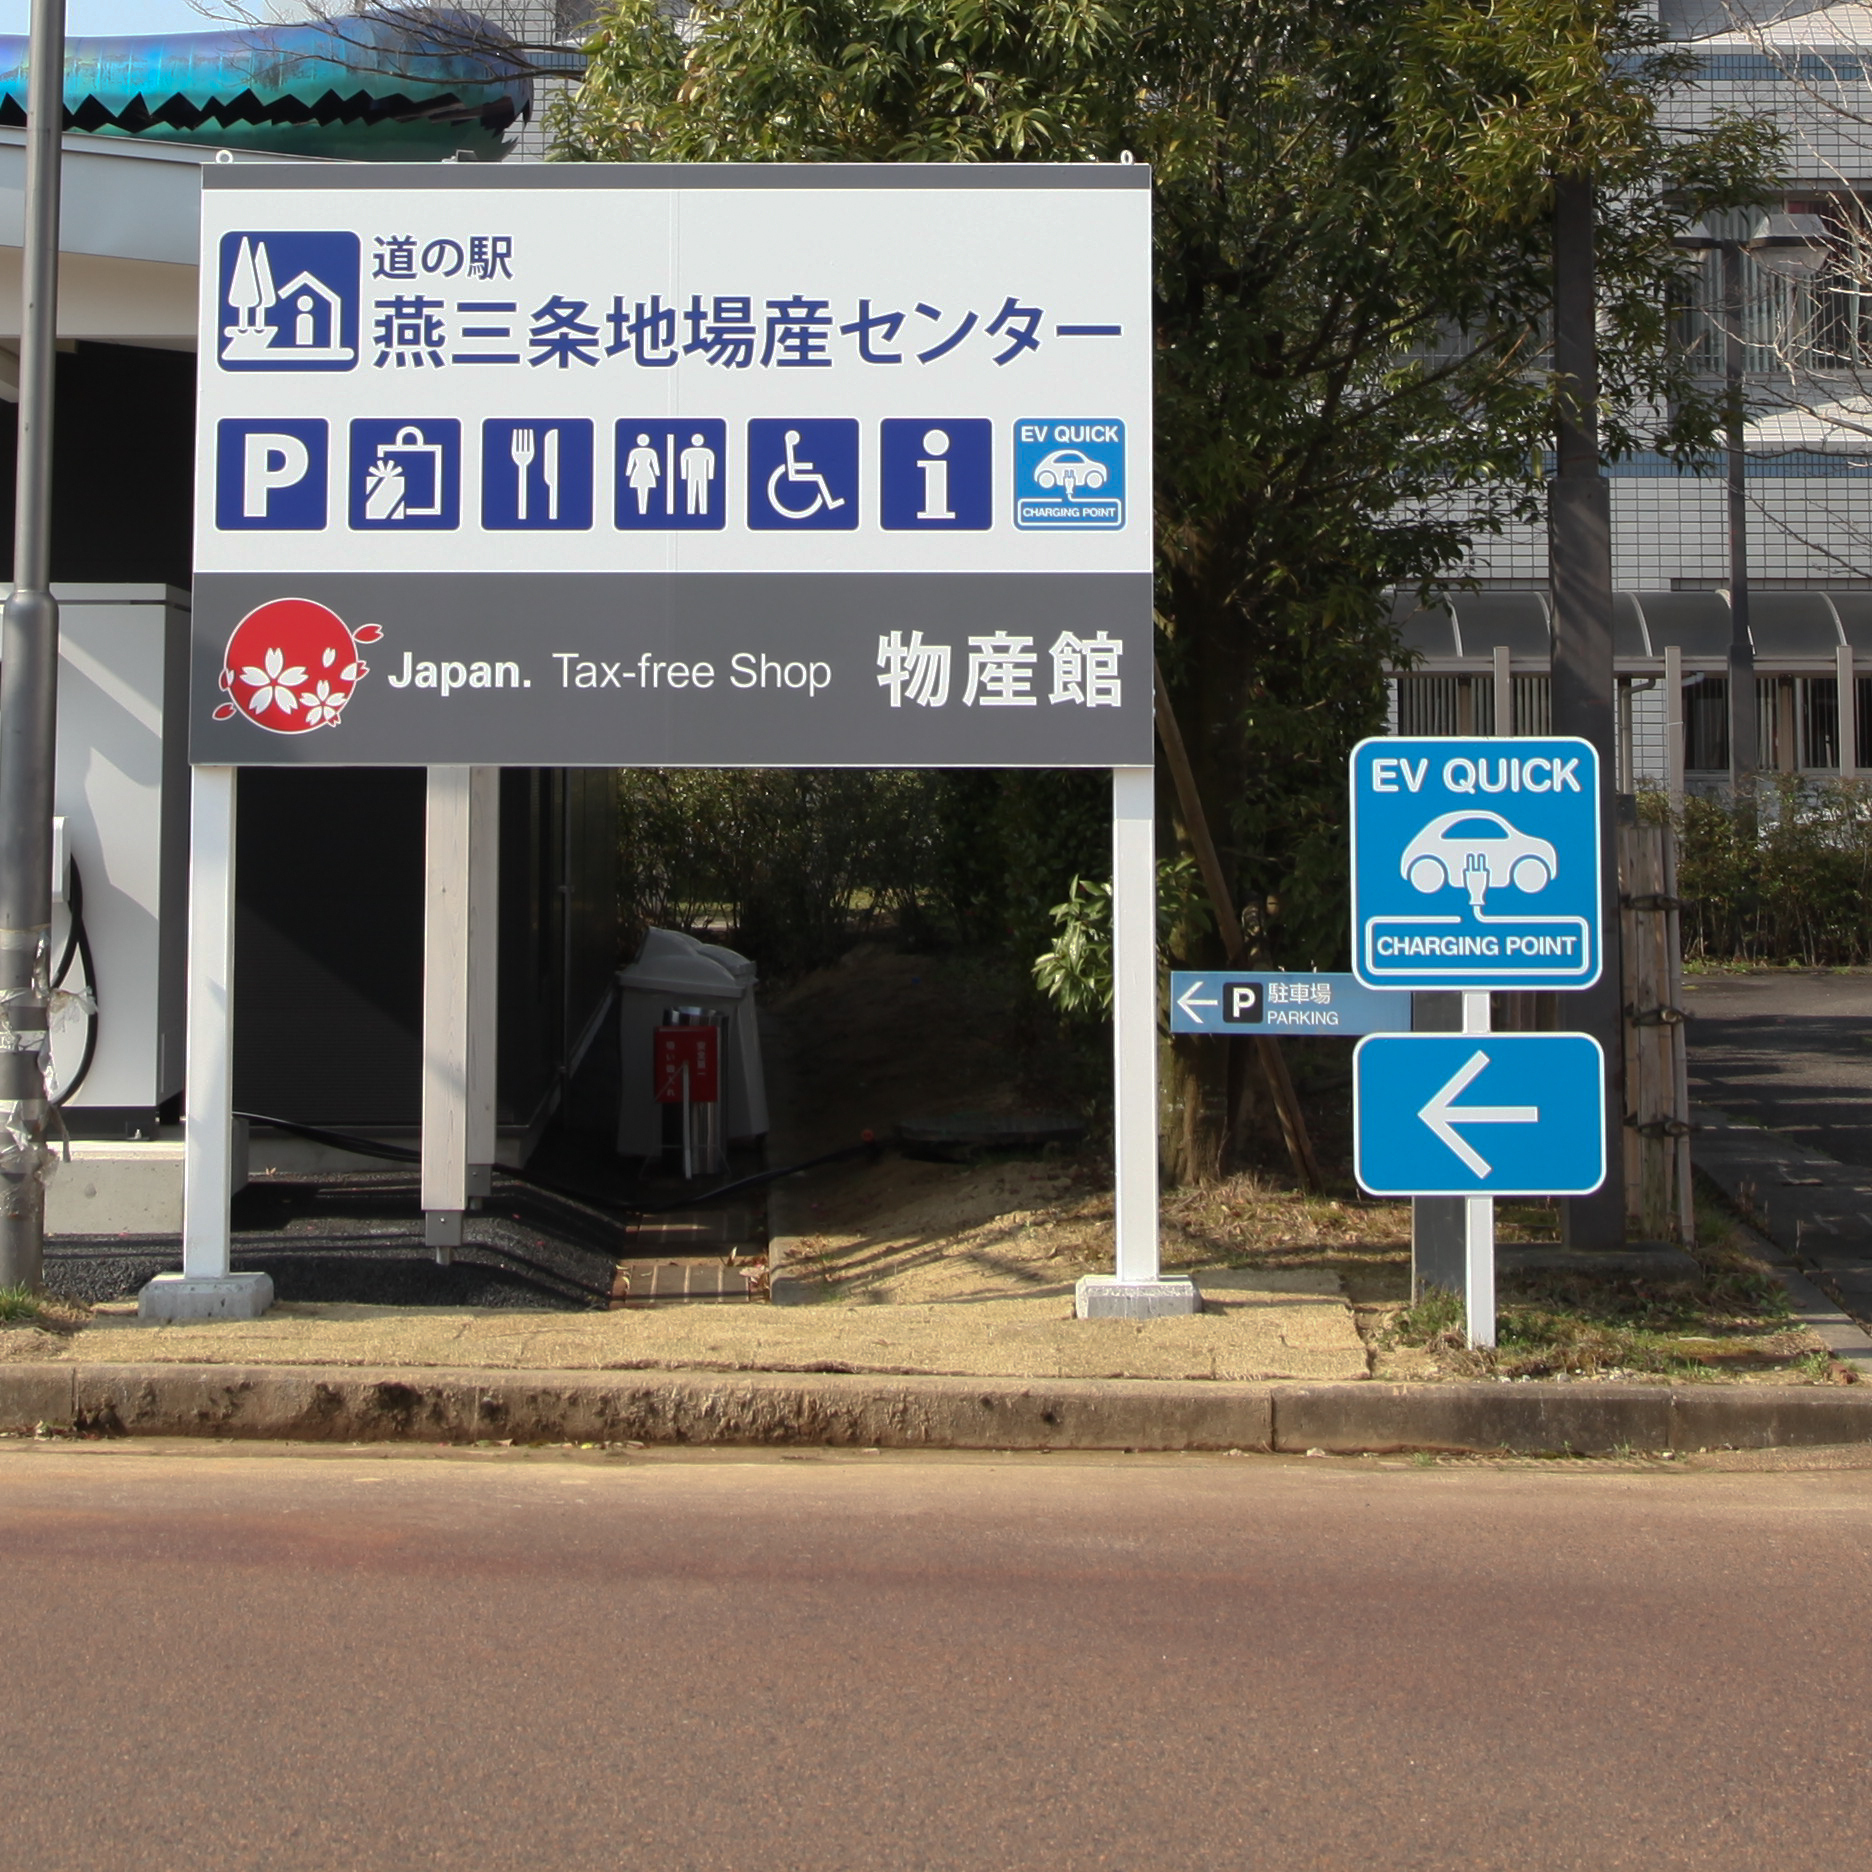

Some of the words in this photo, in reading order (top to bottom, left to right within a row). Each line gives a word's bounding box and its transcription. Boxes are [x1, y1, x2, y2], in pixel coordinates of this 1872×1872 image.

[372, 235, 514, 281] 道の駅
[372, 294, 1123, 370] 燕三条地場産センター
[1021, 426, 1048, 443] EV
[1054, 426, 1120, 444] QUICK
[1023, 507, 1080, 518] CHARGING
[1082, 507, 1116, 518] POINT
[387, 651, 531, 698] Japan.
[553, 652, 716, 690] Tax-free
[730, 653, 832, 698] Shop
[876, 630, 1124, 709] 物産館
[1371, 757, 1430, 793] EV
[1443, 757, 1582, 794] QUICK
[1376, 935, 1500, 957] CHARGING
[1506, 935, 1577, 956] POINT
[1267, 981, 1332, 1006] 駐車場
[1267, 1010, 1339, 1027] PARKING
